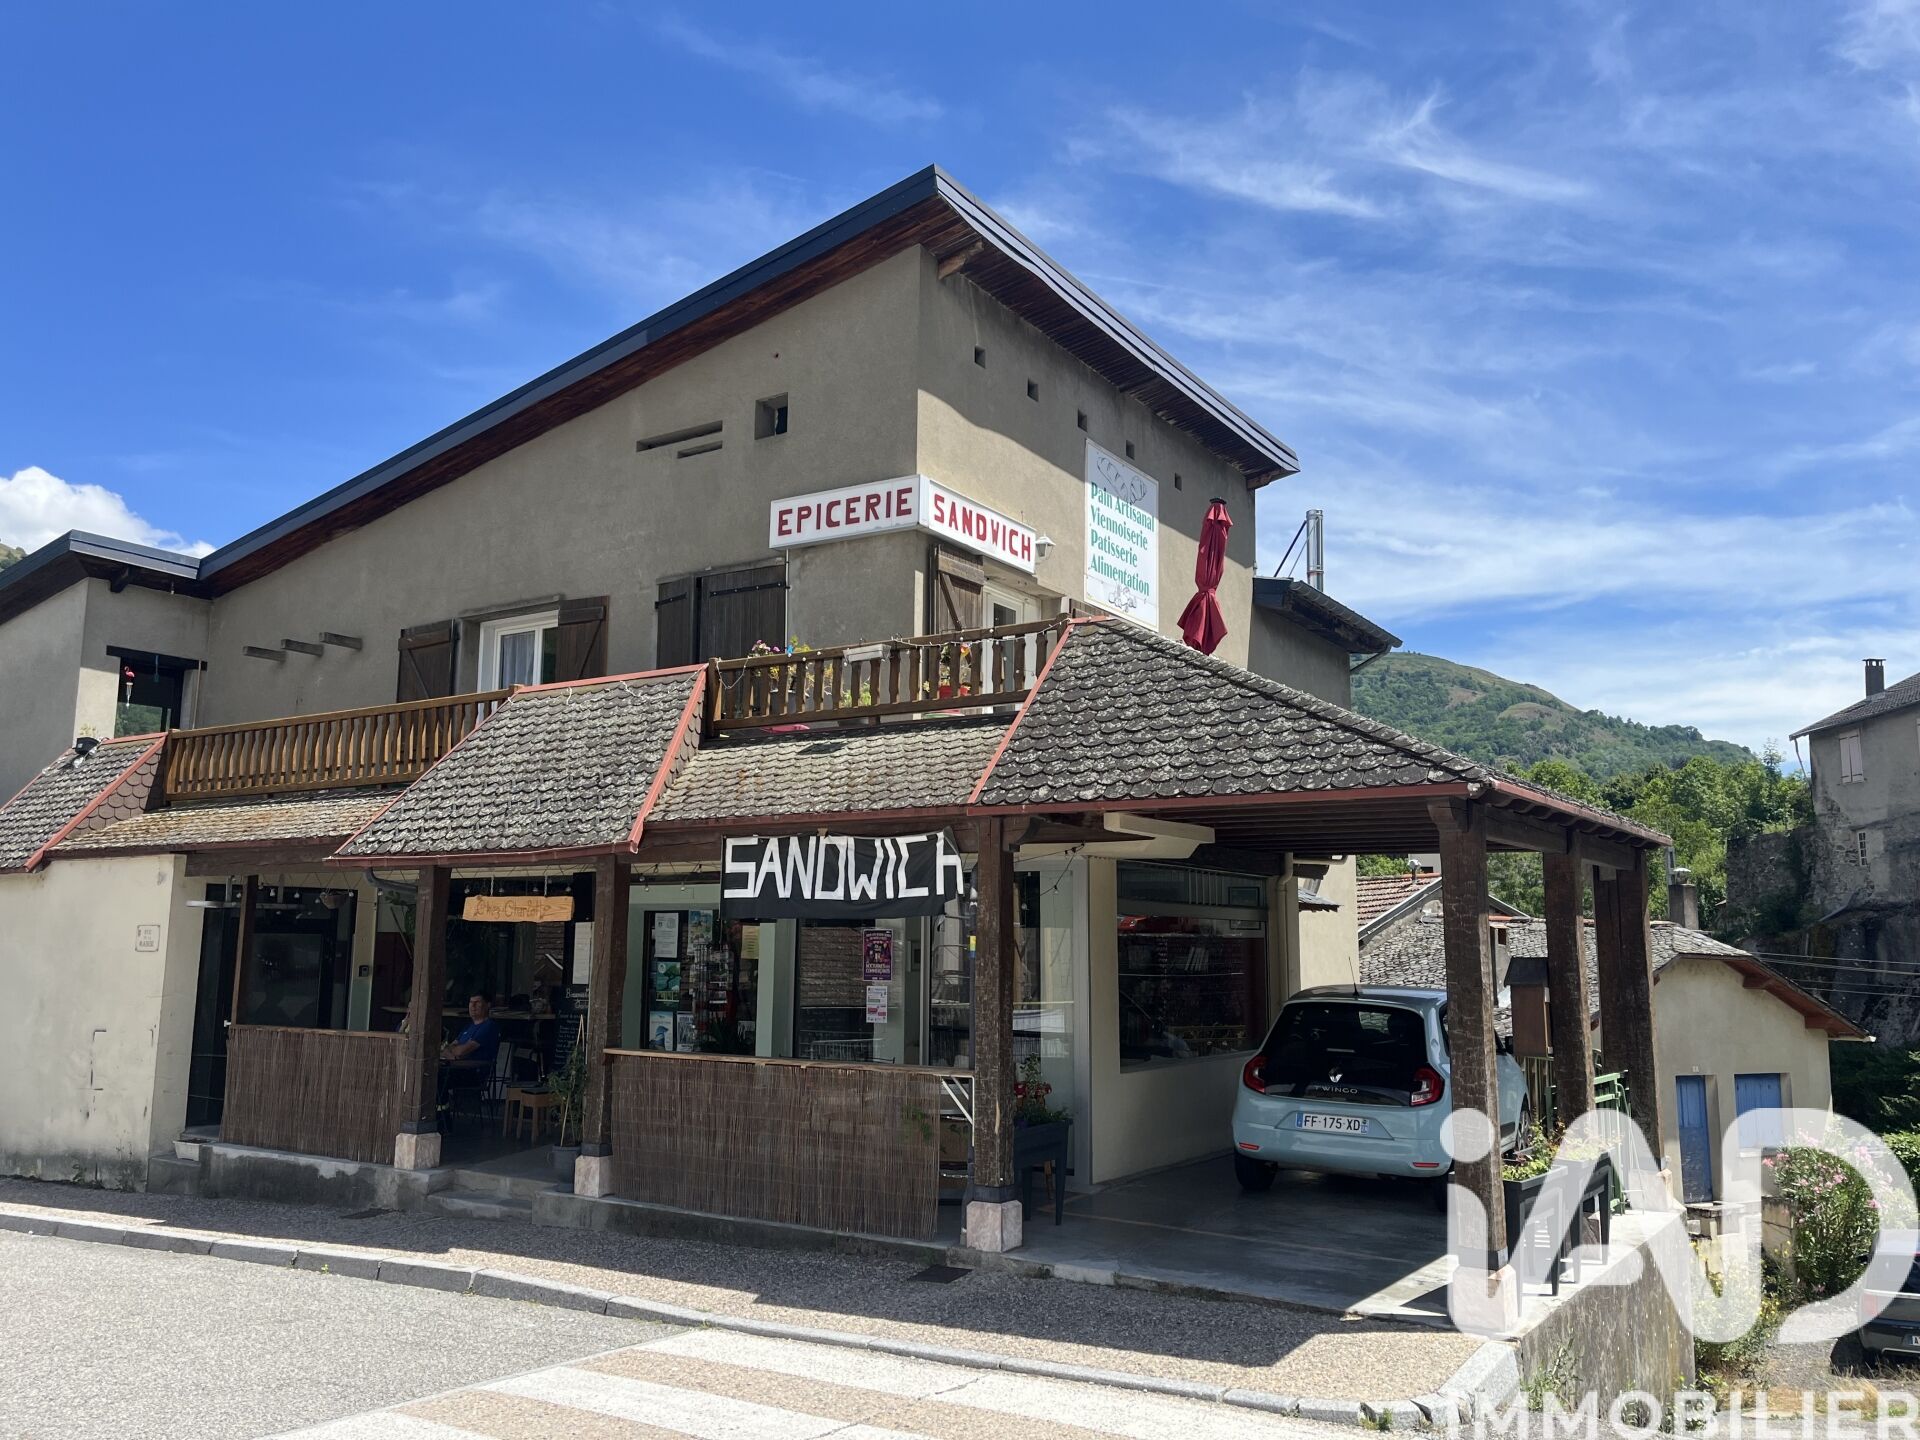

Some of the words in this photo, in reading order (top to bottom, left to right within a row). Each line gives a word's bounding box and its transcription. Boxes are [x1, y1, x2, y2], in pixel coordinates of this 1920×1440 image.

[777, 487, 913, 537] EPICERIE
[934, 493, 1031, 562] SANDWICH
[1090, 505, 1148, 550] Viennoiserie
[1091, 482, 1113, 508] Pain
[1115, 499, 1155, 532] Artisanal
[1090, 528, 1138, 568] Patisserie
[1090, 553, 1150, 597] Alimentation
[723, 832, 964, 901] SANDWICH
[1314, 1085, 1358, 1094] TWINGO
